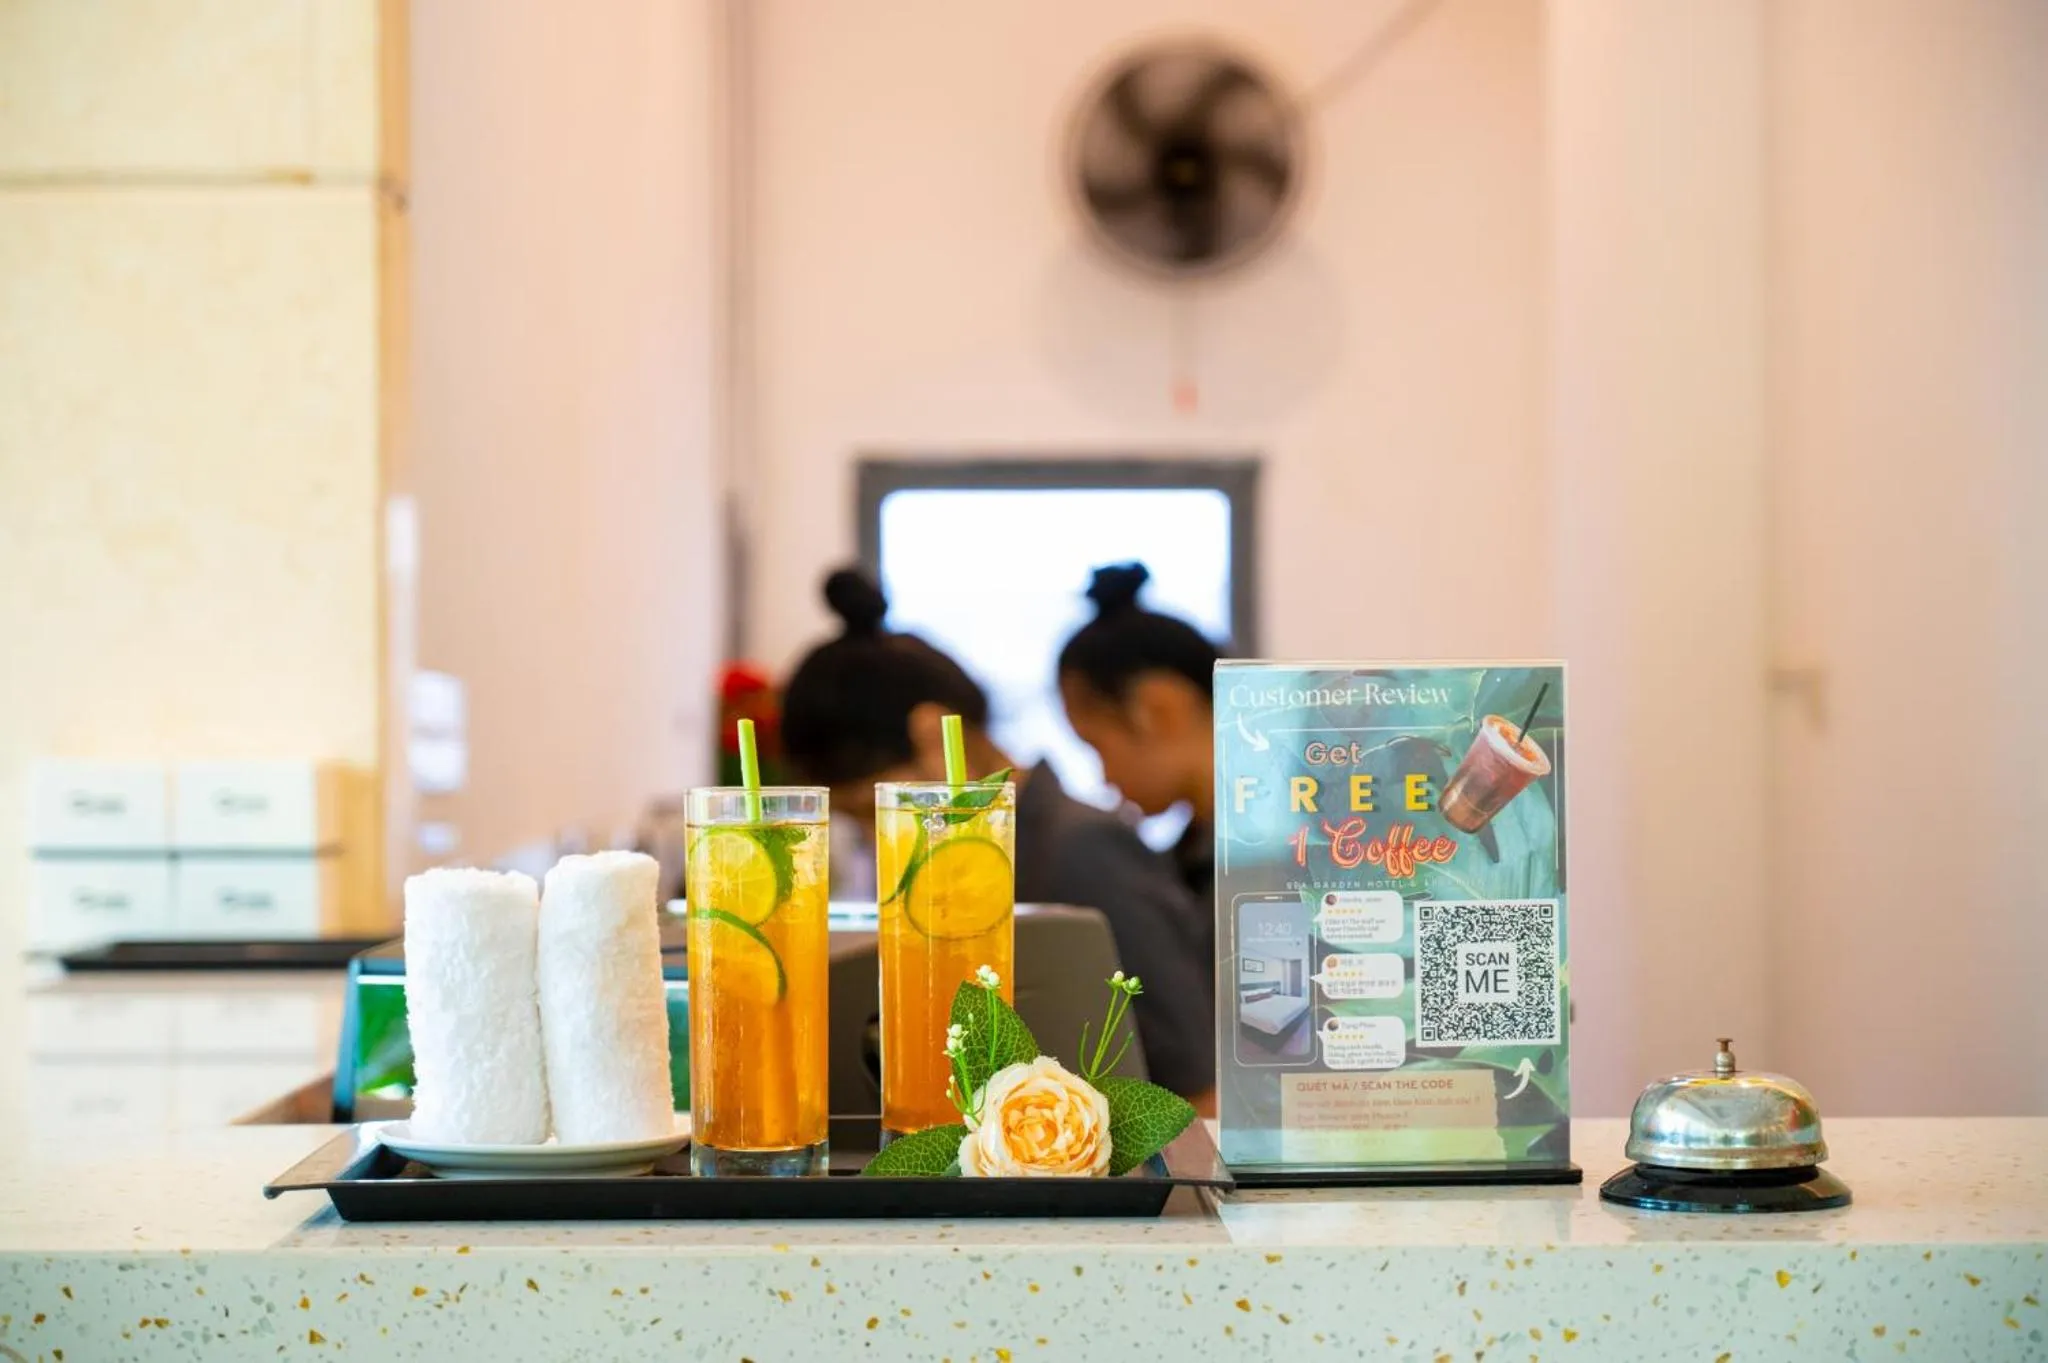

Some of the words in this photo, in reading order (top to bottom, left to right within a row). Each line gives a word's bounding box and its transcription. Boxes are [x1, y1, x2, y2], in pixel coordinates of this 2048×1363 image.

[1229, 683, 1357, 707] Customer
[1364, 682, 1453, 706] Review
[1305, 742, 1361, 766] Get
[1234, 774, 1430, 813] FREE
[1287, 826, 1309, 868] 1
[1322, 817, 1459, 879] Coffee
[1367, 879, 1404, 889] HOTEL
[1465, 952, 1510, 966] SCAN
[1465, 969, 1510, 993] ME
[1360, 1080, 1392, 1091] SCAN
[1395, 1079, 1418, 1090] THE
[1421, 1078, 1455, 1090] CODE
